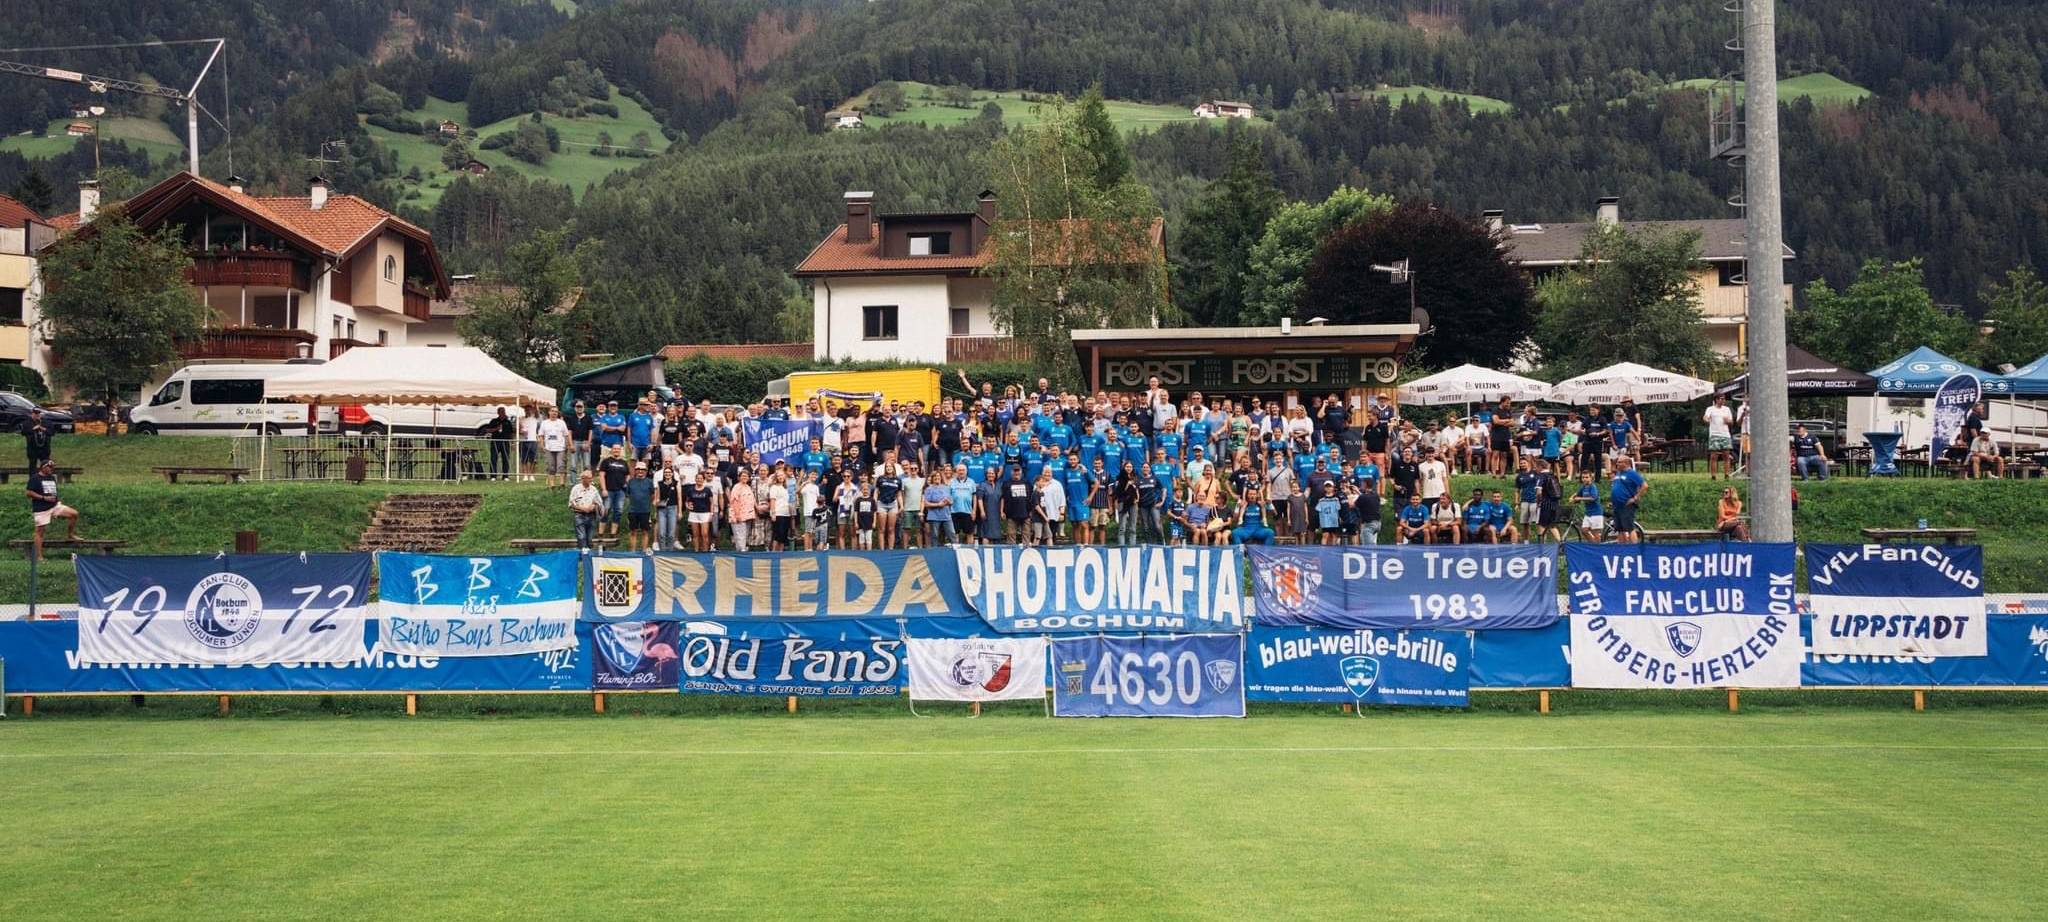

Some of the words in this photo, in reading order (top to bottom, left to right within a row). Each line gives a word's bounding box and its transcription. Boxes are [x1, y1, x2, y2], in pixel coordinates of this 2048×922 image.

[1106, 360, 1196, 386] FORST
[1233, 358, 1324, 384] FORST
[1583, 378, 1608, 386] VELTINS
[1941, 393, 1977, 405] TREFF
[1343, 552, 1405, 580] Die
[1423, 552, 1553, 580] Treuen
[1603, 556, 1651, 580] VfL
[1658, 553, 1753, 580] BOCHUM
[1812, 550, 1860, 586] VfL
[1863, 544, 1918, 562] Fan
[1920, 545, 1981, 590] Club
[200, 574, 249, 590] FAN-CLUB
[411, 564, 439, 606] B
[467, 557, 493, 598] B
[516, 563, 550, 599] B
[653, 555, 950, 617] RHEDA
[957, 547, 1242, 627] PHOTOMAFIA
[98, 585, 168, 636] 19
[281, 584, 354, 635] 72
[1409, 593, 1489, 621] 1983
[1625, 588, 1745, 614] FAN-CLUB
[230, 609, 260, 645] JUNGEN
[390, 616, 440, 646] Bistro
[446, 618, 494, 650] Boys
[500, 616, 566, 645] Bochum
[1014, 613, 1184, 629] BOCHUM
[1570, 571, 1793, 685] STROMBERG-HERZEBROCK
[1830, 614, 1970, 639] LIPPSTADT
[682, 636, 757, 679] Old
[1260, 629, 1457, 673] blau-weiße-brille
[1090, 652, 1200, 706] 4630
[1264, 685, 1289, 693] tragen
[1396, 687, 1423, 695] hinaus
[1434, 688, 1447, 696] die
[1448, 689, 1466, 697] Welt
